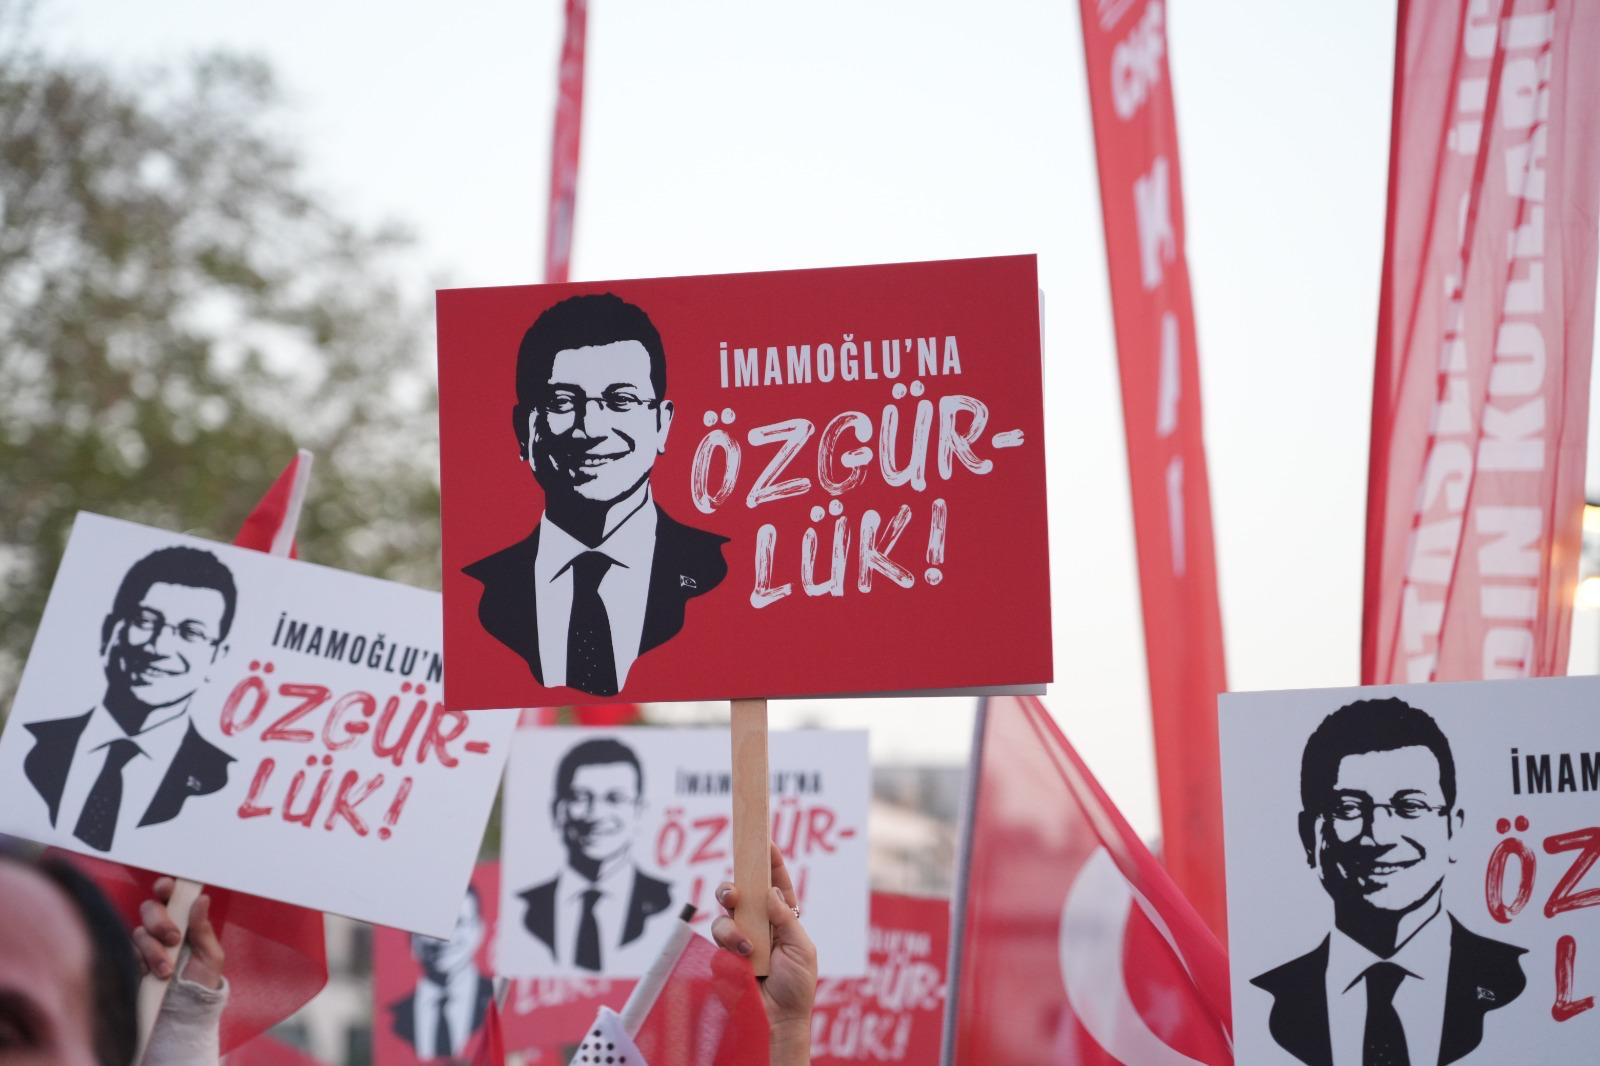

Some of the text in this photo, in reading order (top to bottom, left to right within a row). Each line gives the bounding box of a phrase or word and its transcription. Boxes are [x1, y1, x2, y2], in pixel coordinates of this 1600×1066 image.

[720, 333, 962, 388] İMAMOĞLU'NA
[691, 380, 1025, 514] ÖZGÜR-
[750, 498, 948, 609] LÜK!
[220, 660, 491, 769] ÖZGÜR-
[237, 754, 413, 841] LÜK!
[1511, 747, 1600, 795] İMAM
[656, 798, 857, 868] ÖZÜR-
[1486, 815, 1600, 923] ÖZ
